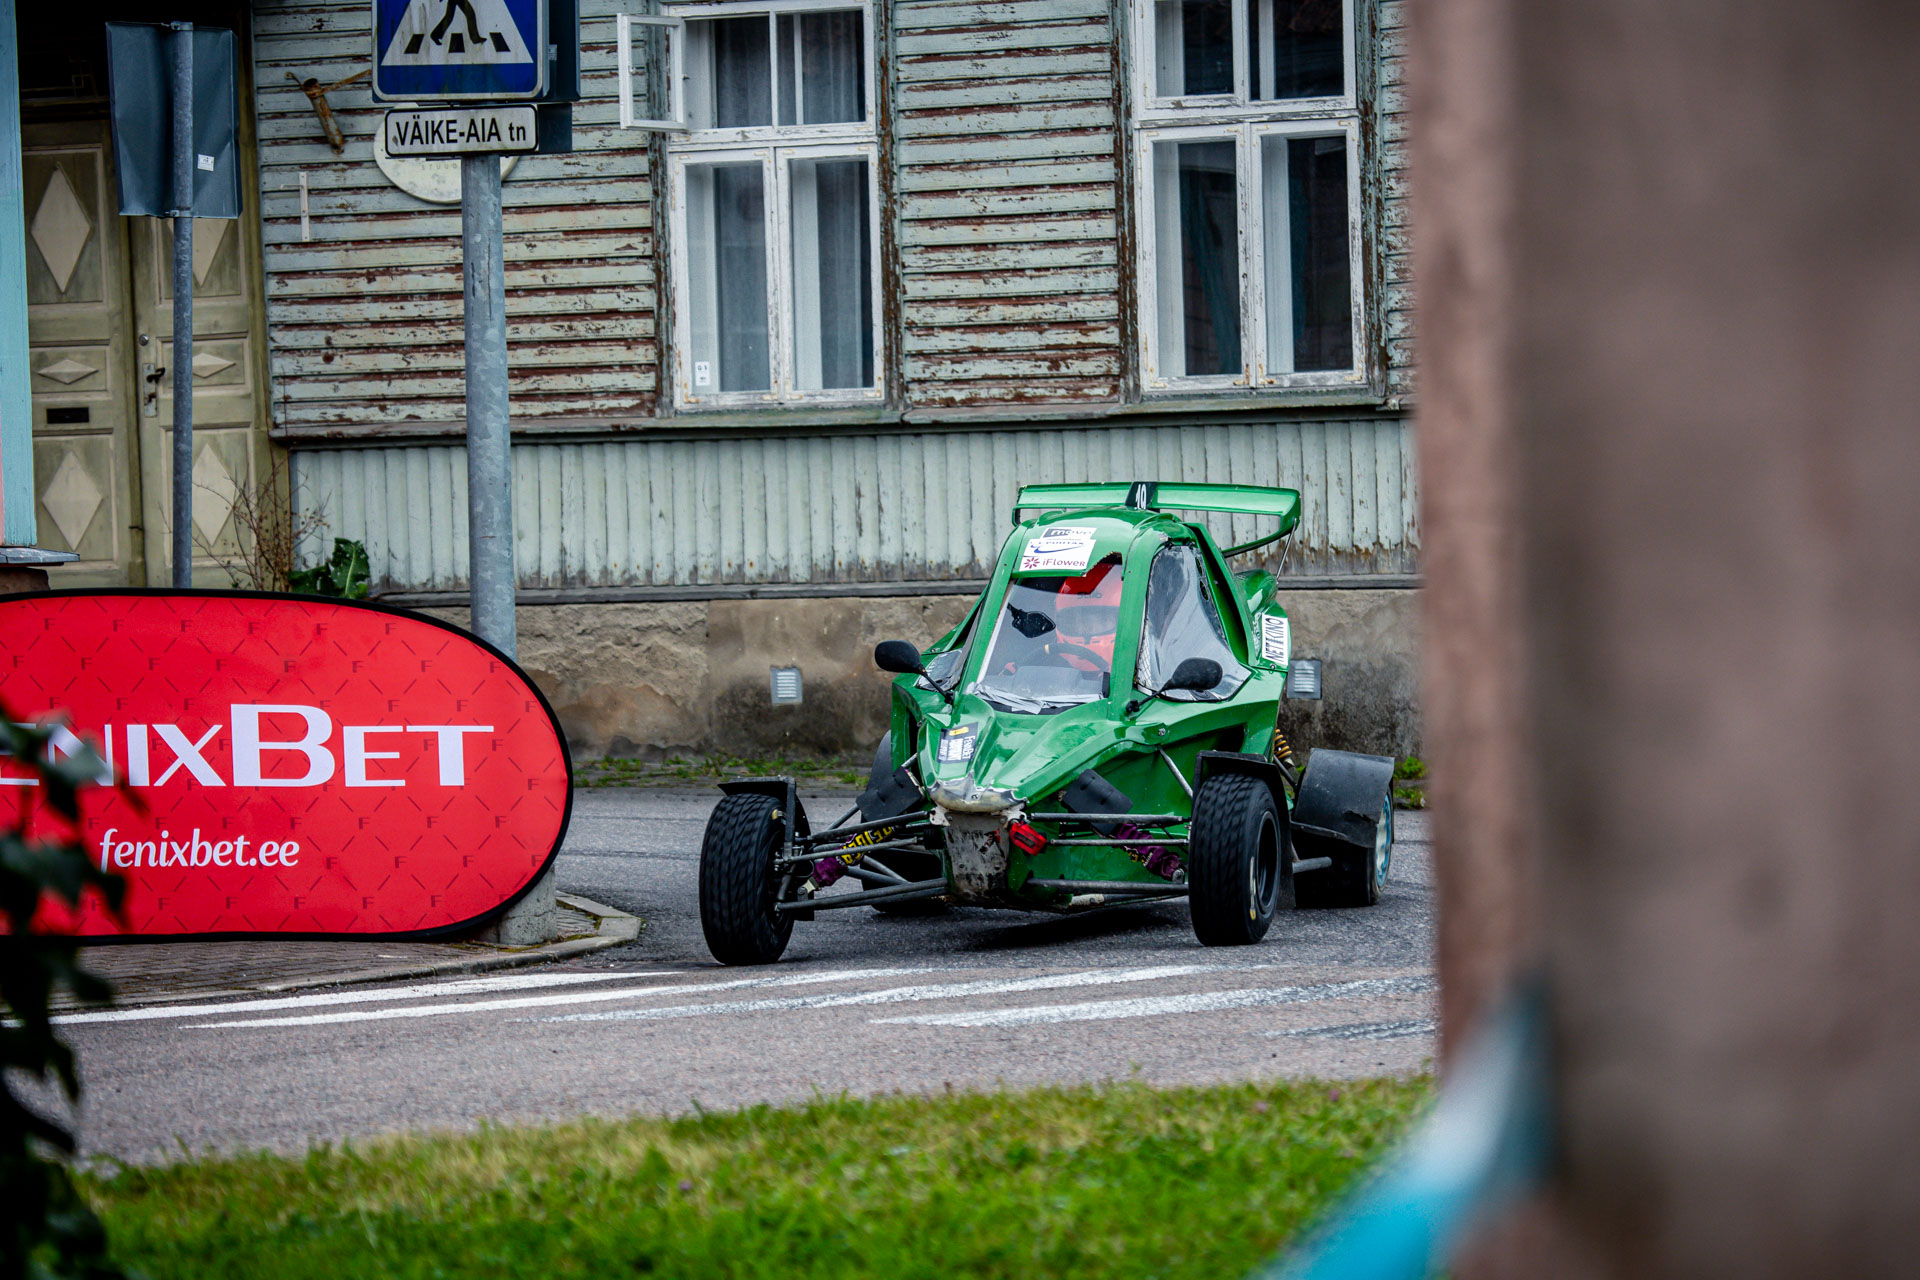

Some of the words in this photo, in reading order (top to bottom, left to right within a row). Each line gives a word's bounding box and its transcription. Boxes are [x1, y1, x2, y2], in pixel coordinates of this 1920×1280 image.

[396, 114, 502, 146] VÄIKE-AIA
[508, 122, 527, 142] tn
[100, 828, 300, 873] fenixbet.ee
